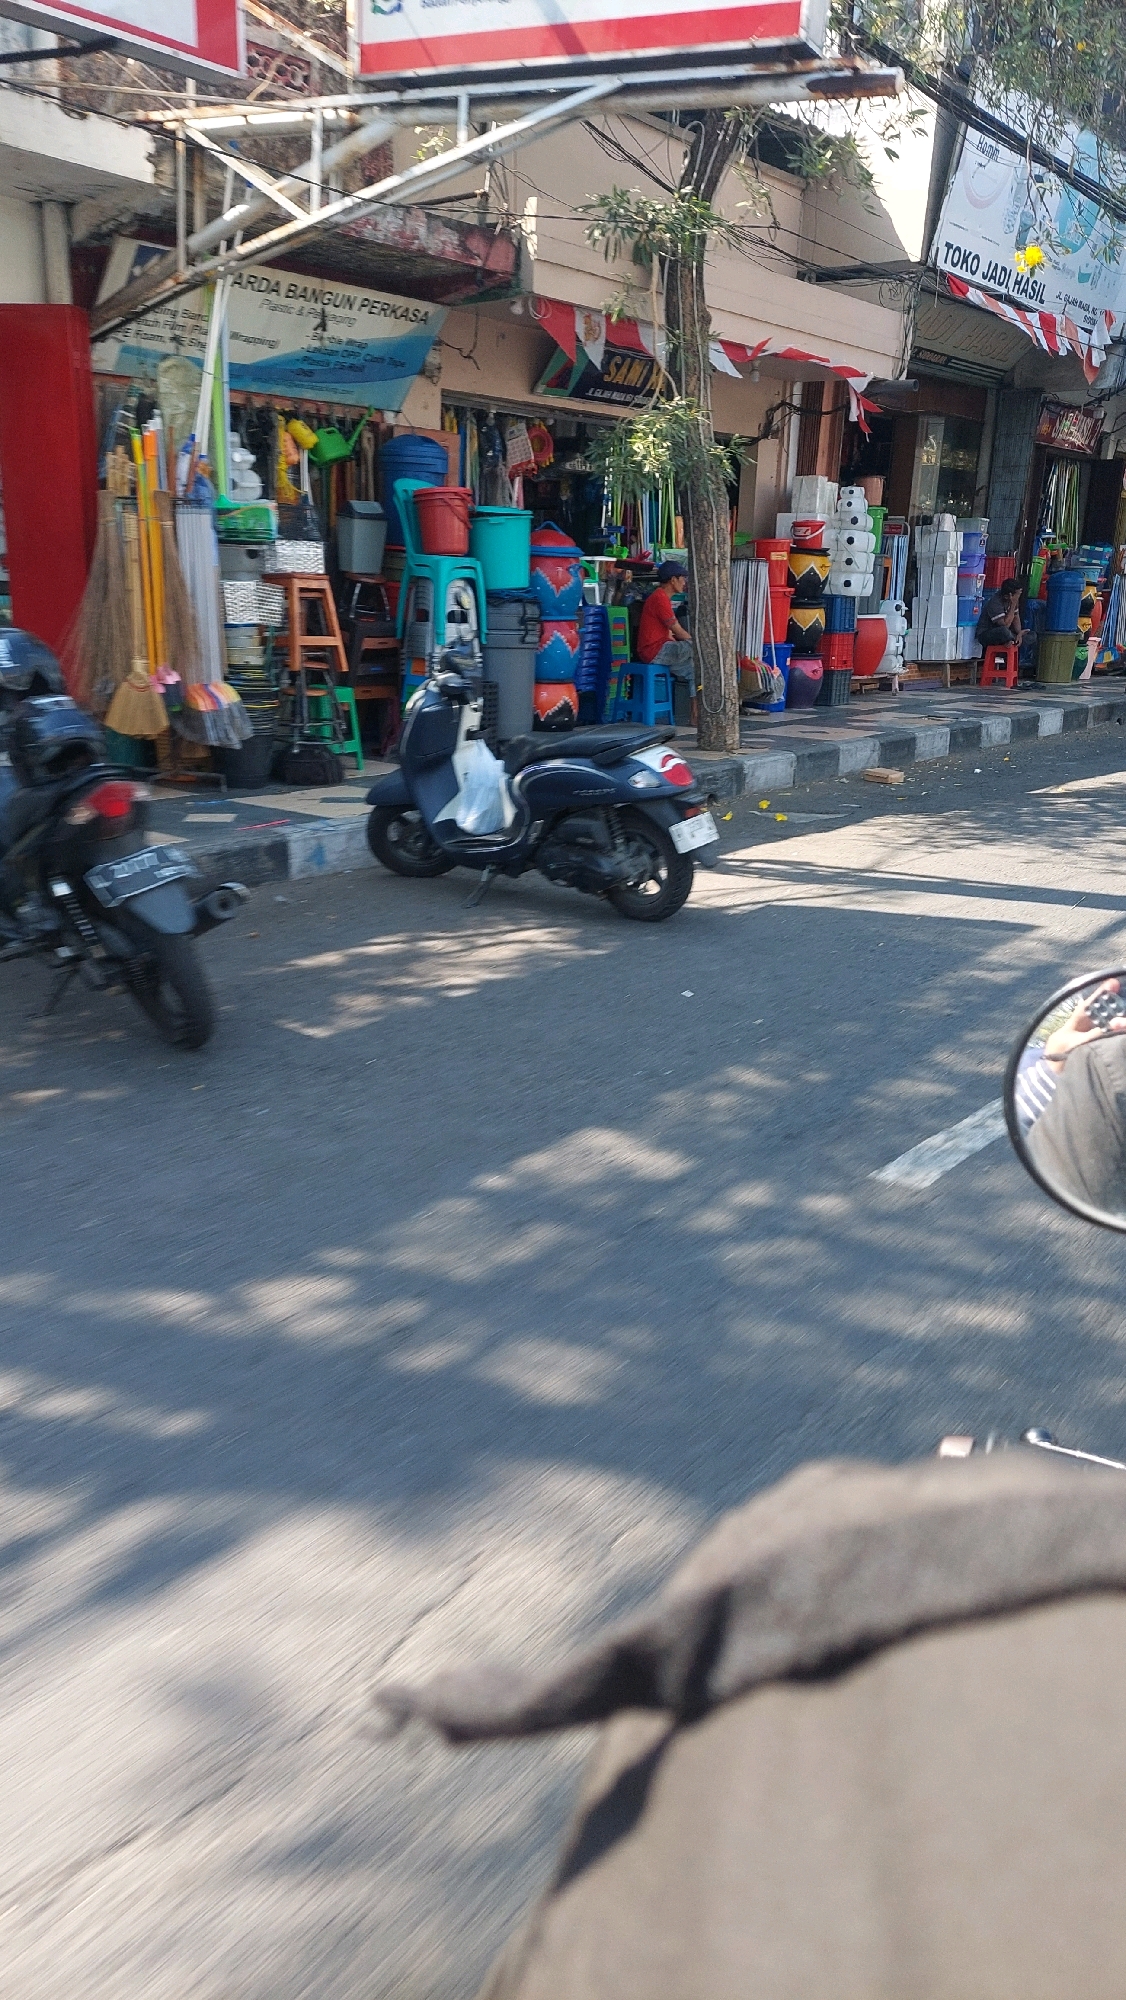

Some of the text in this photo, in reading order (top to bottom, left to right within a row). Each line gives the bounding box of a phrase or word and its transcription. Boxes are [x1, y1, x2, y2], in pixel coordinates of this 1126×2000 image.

[230, 272, 430, 325] ARDA BANGUN PERKASA
[944, 241, 1047, 305] TOKO JADI HASIL
[259, 298, 357, 327] Plastic & Paaging
